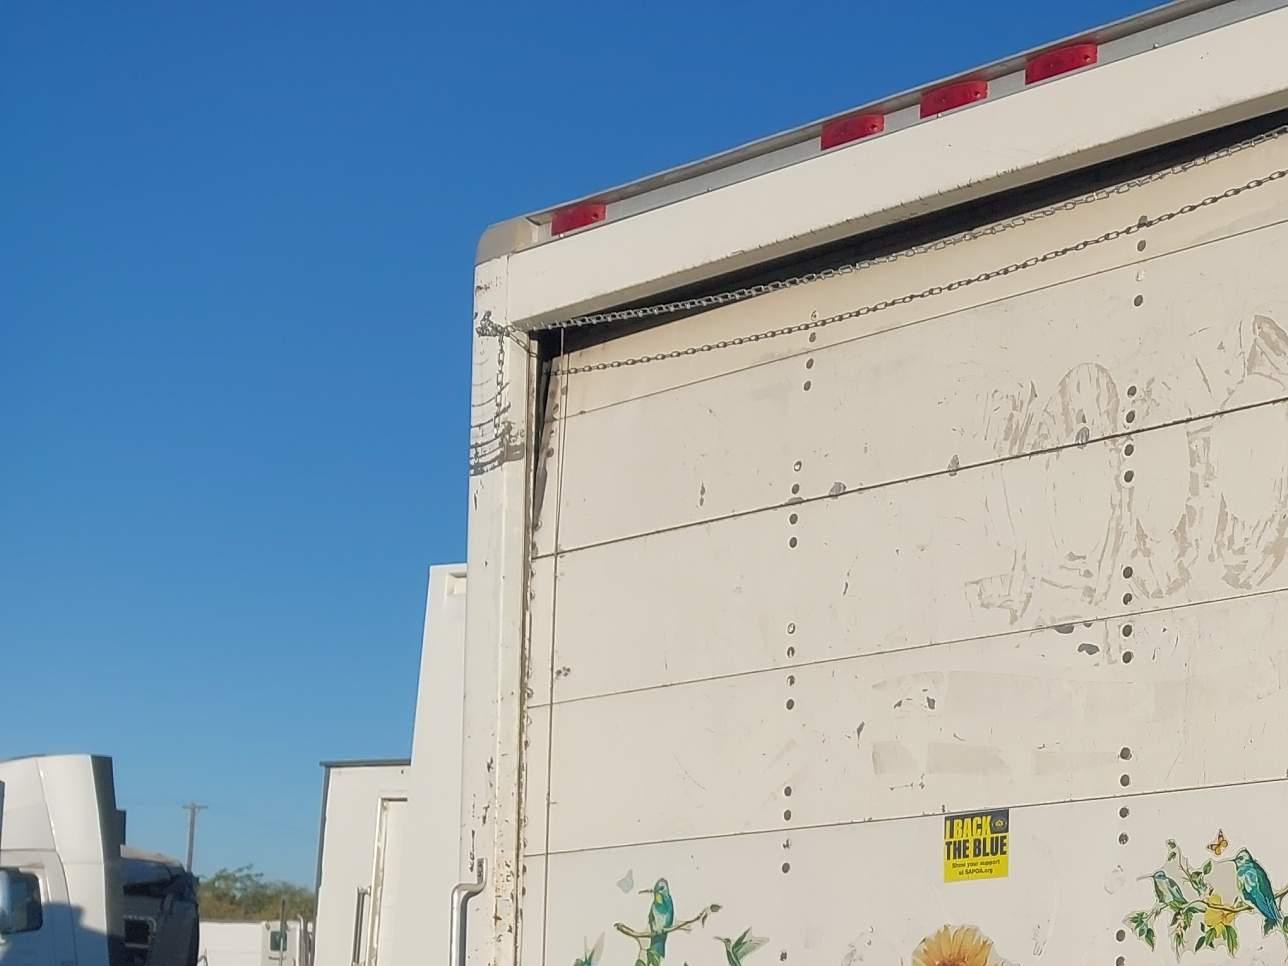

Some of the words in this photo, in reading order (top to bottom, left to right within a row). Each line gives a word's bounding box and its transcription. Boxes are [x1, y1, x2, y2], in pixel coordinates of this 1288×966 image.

[946, 819, 951, 838] I
[953, 816, 991, 838] BACK
[945, 839, 970, 860] THE
[972, 835, 1007, 858] BLUE
